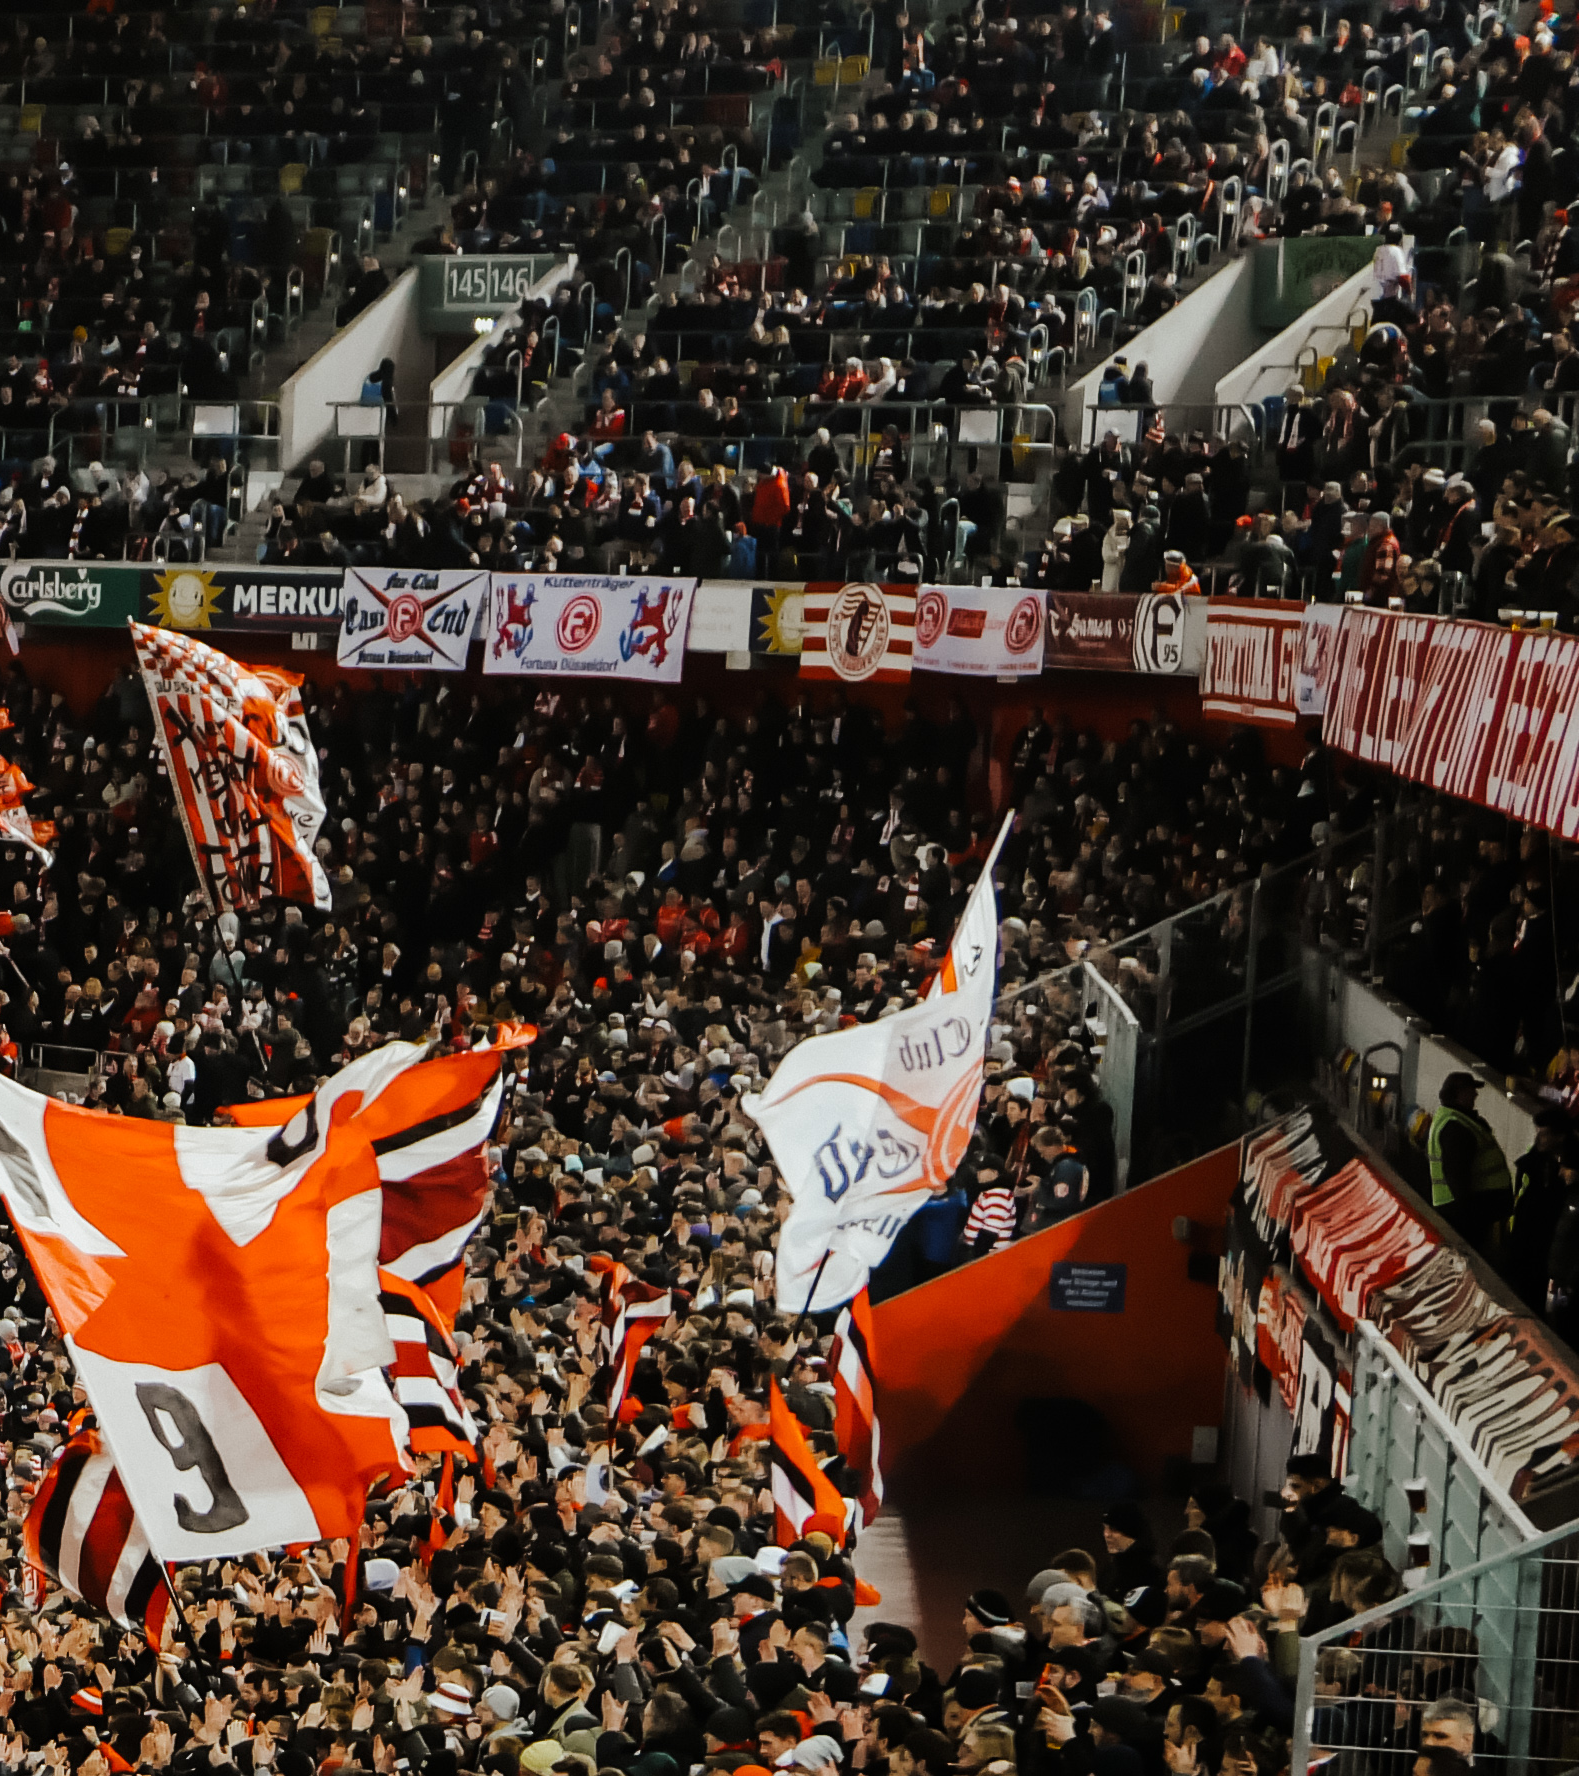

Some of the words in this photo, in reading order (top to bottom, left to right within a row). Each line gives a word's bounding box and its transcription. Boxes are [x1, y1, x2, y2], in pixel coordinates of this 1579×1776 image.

[449, 268, 486, 298] 145
[491, 266, 529, 297] 146
[0, 565, 102, 608] Carlsberg
[543, 575, 636, 592] Kuttenträger
[232, 583, 344, 617] MERKU
[520, 656, 557, 672] Fortuna
[560, 657, 619, 673] Düsseldorf
[1162, 644, 1180, 665] 95
